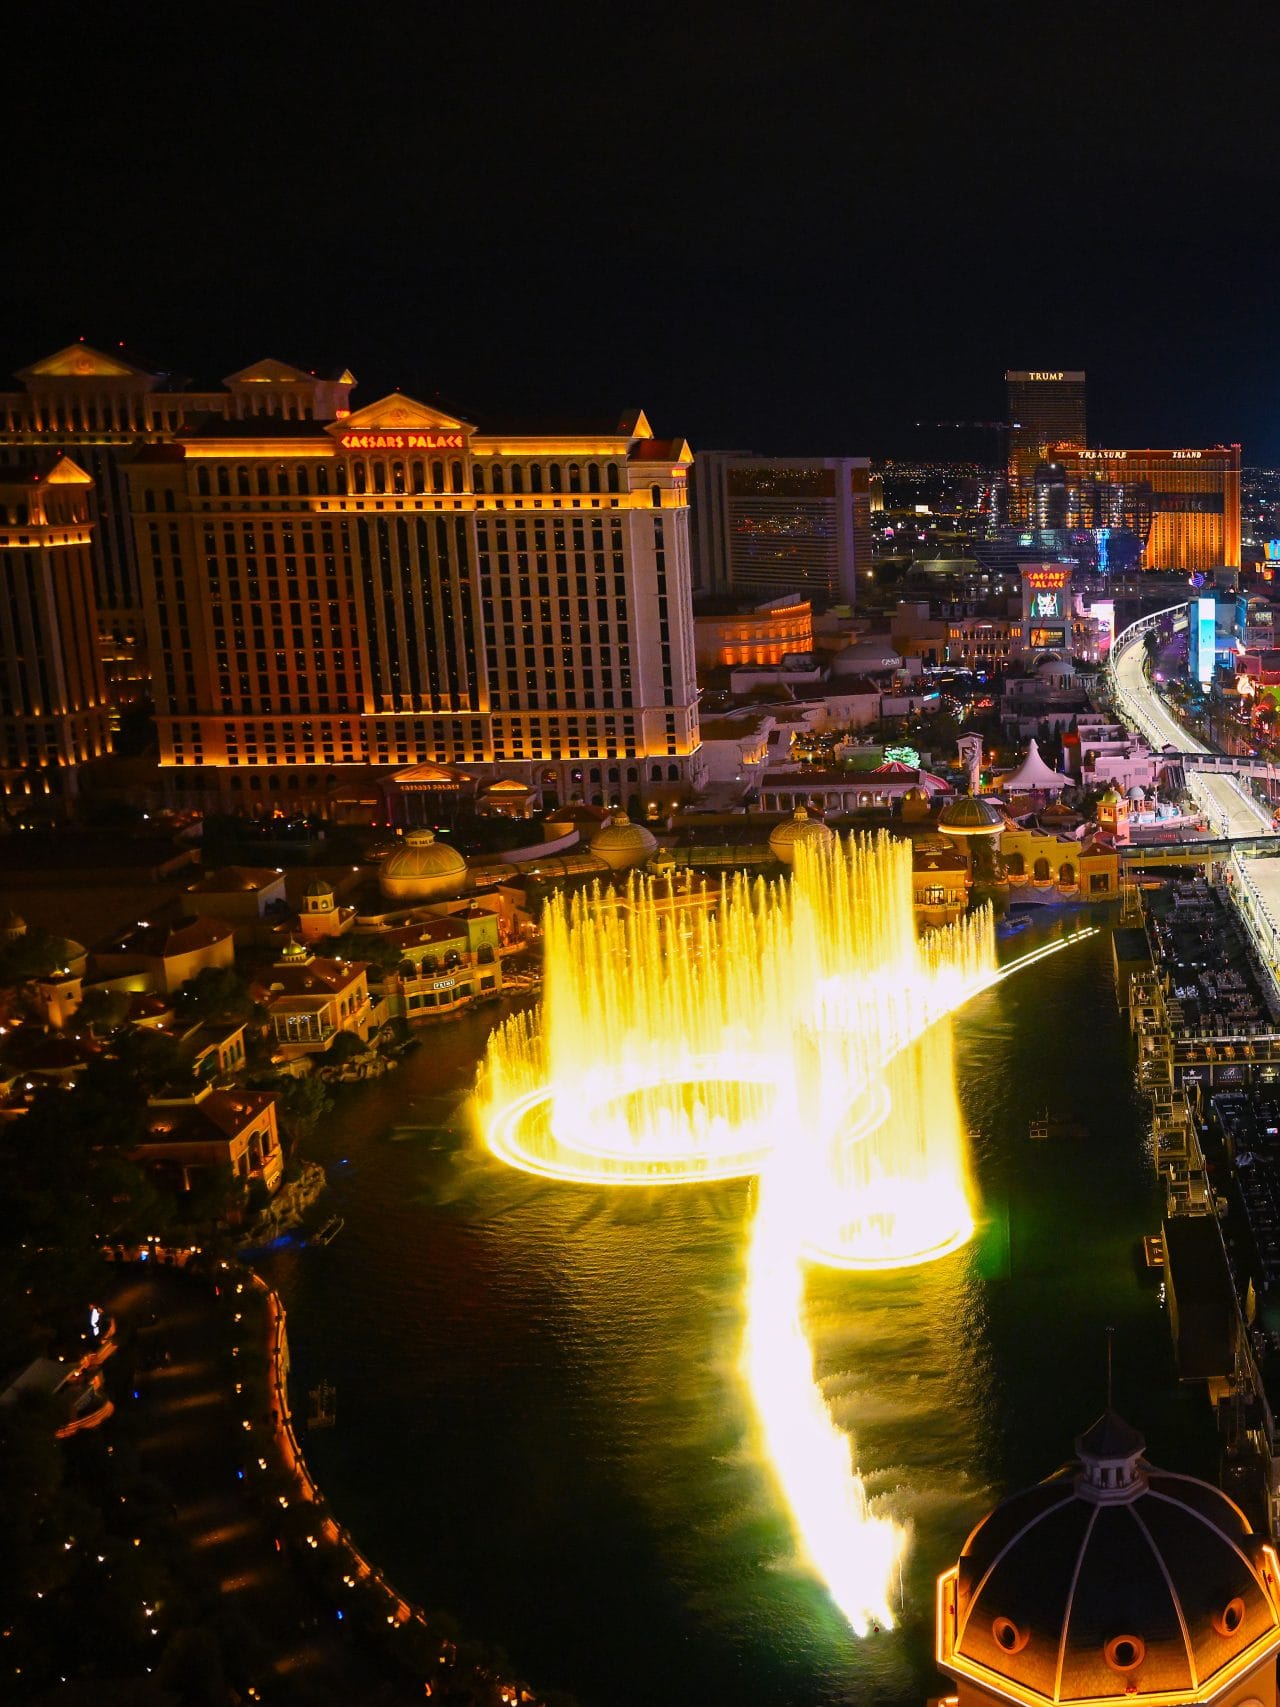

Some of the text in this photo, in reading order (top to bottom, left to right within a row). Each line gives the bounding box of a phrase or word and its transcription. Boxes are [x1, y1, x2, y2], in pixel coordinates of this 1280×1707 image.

[1029, 372, 1064, 381] TRUMP
[341, 435, 463, 449] CAESARS PALACE
[1078, 451, 1202, 459] TREASURE ISLAND
[1027, 572, 1065, 581] CAESARS
[1029, 580, 1065, 588] PALACE
